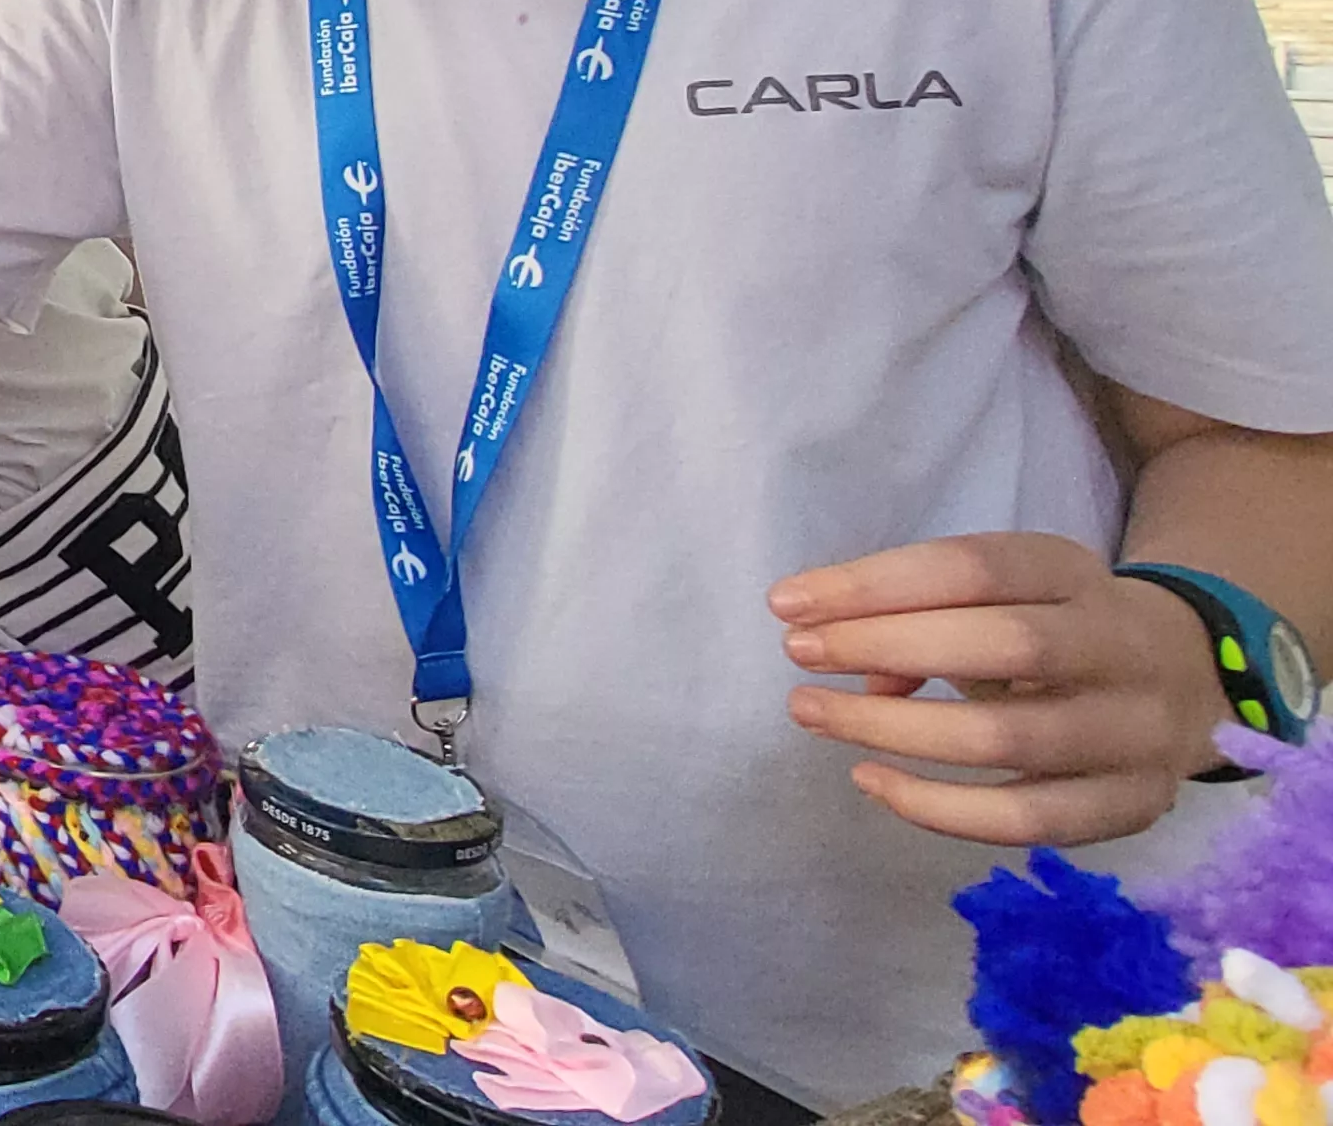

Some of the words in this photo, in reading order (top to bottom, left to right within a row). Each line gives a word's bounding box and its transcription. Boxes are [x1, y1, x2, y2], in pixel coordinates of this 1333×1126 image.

[319, 19, 335, 97] Fundación
[686, 70, 963, 117] CARLA
[558, 159, 602, 243] Fundación
[333, 216, 361, 299] Fundación
[488, 363, 527, 441] Fundación
[261, 799, 298, 829] DESDE
[300, 822, 331, 842] 1875
